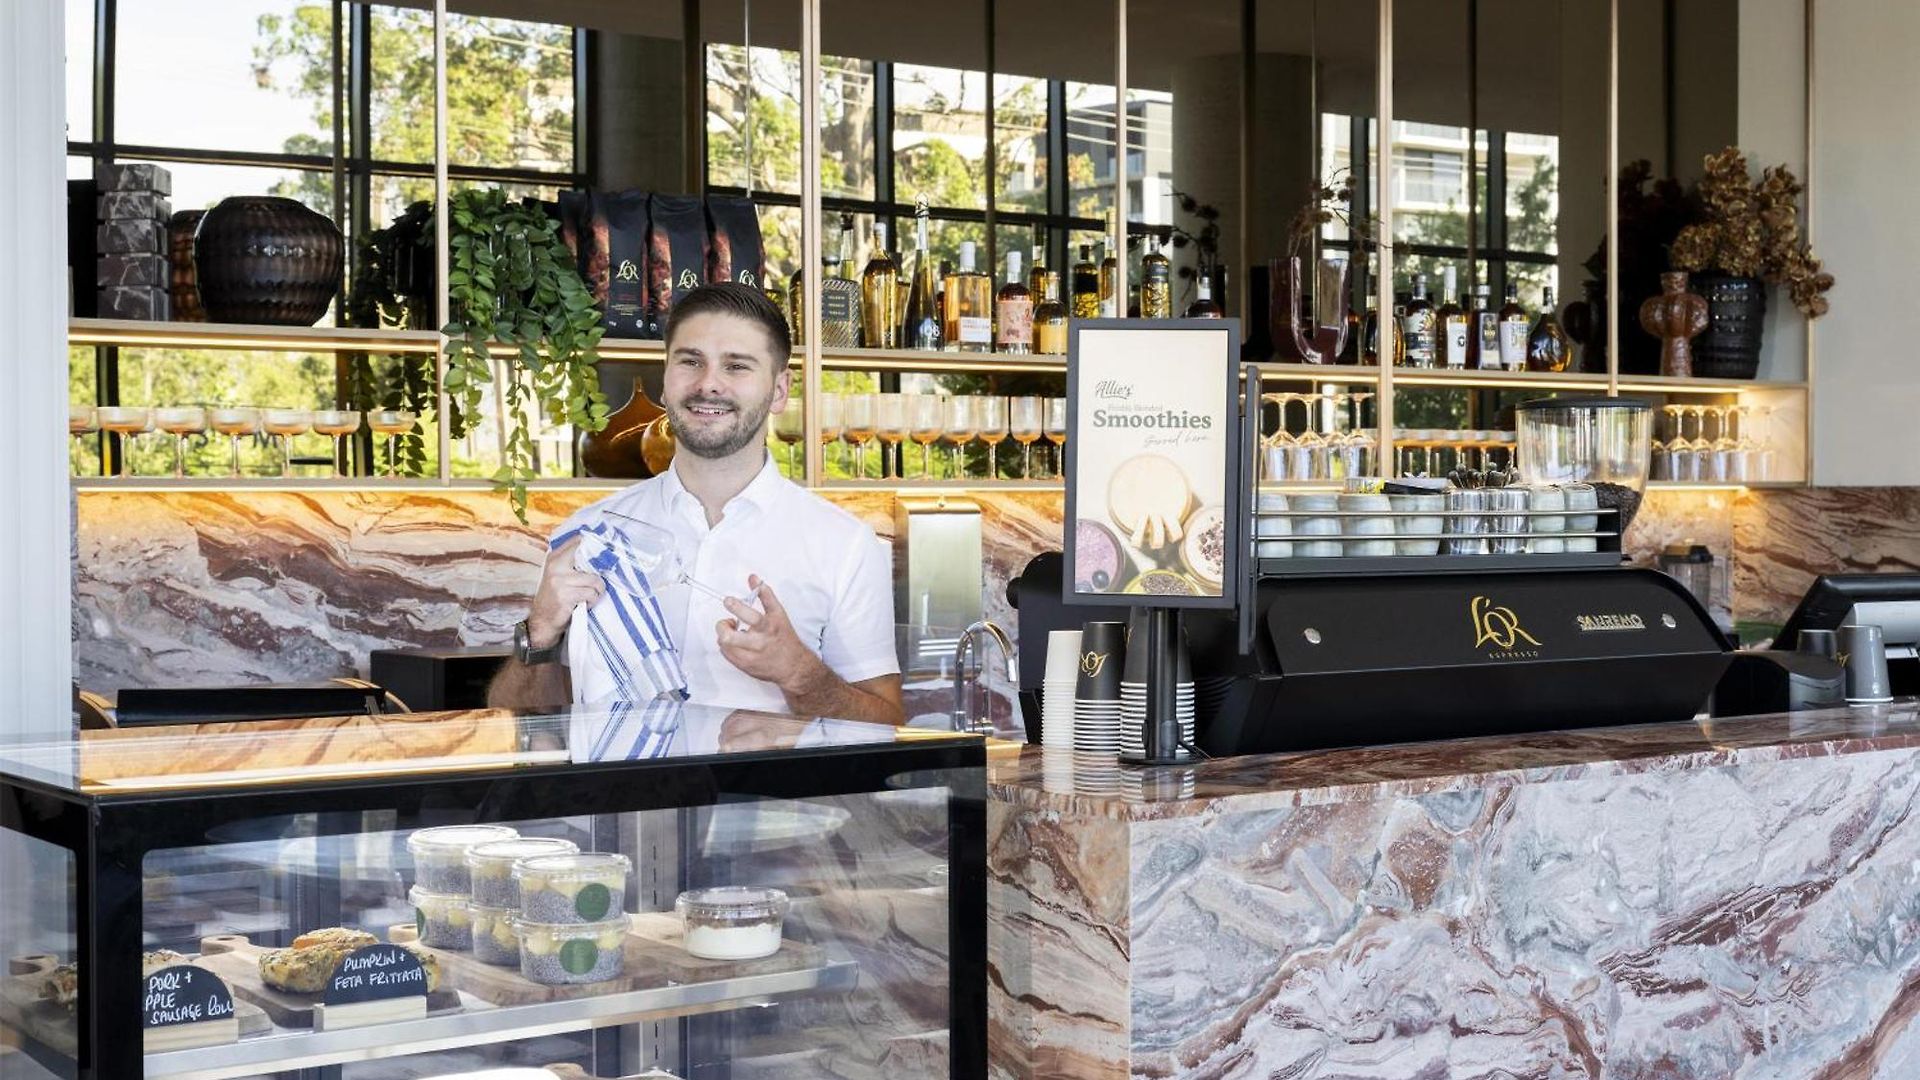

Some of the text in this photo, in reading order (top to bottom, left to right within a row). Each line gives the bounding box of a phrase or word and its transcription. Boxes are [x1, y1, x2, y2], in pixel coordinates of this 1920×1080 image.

[1095, 380, 1133, 400] Allie's
[1092, 409, 1212, 429] Smoothies
[1471, 596, 1543, 649] L'OR
[1489, 651, 1539, 659] ESPRESSO
[344, 950, 406, 972] PUMPKIN +
[149, 971, 193, 994] PORK +
[334, 975, 363, 991] FETA
[145, 993, 176, 1012] PPLE
[150, 1004, 202, 1025] SAUSAGE
